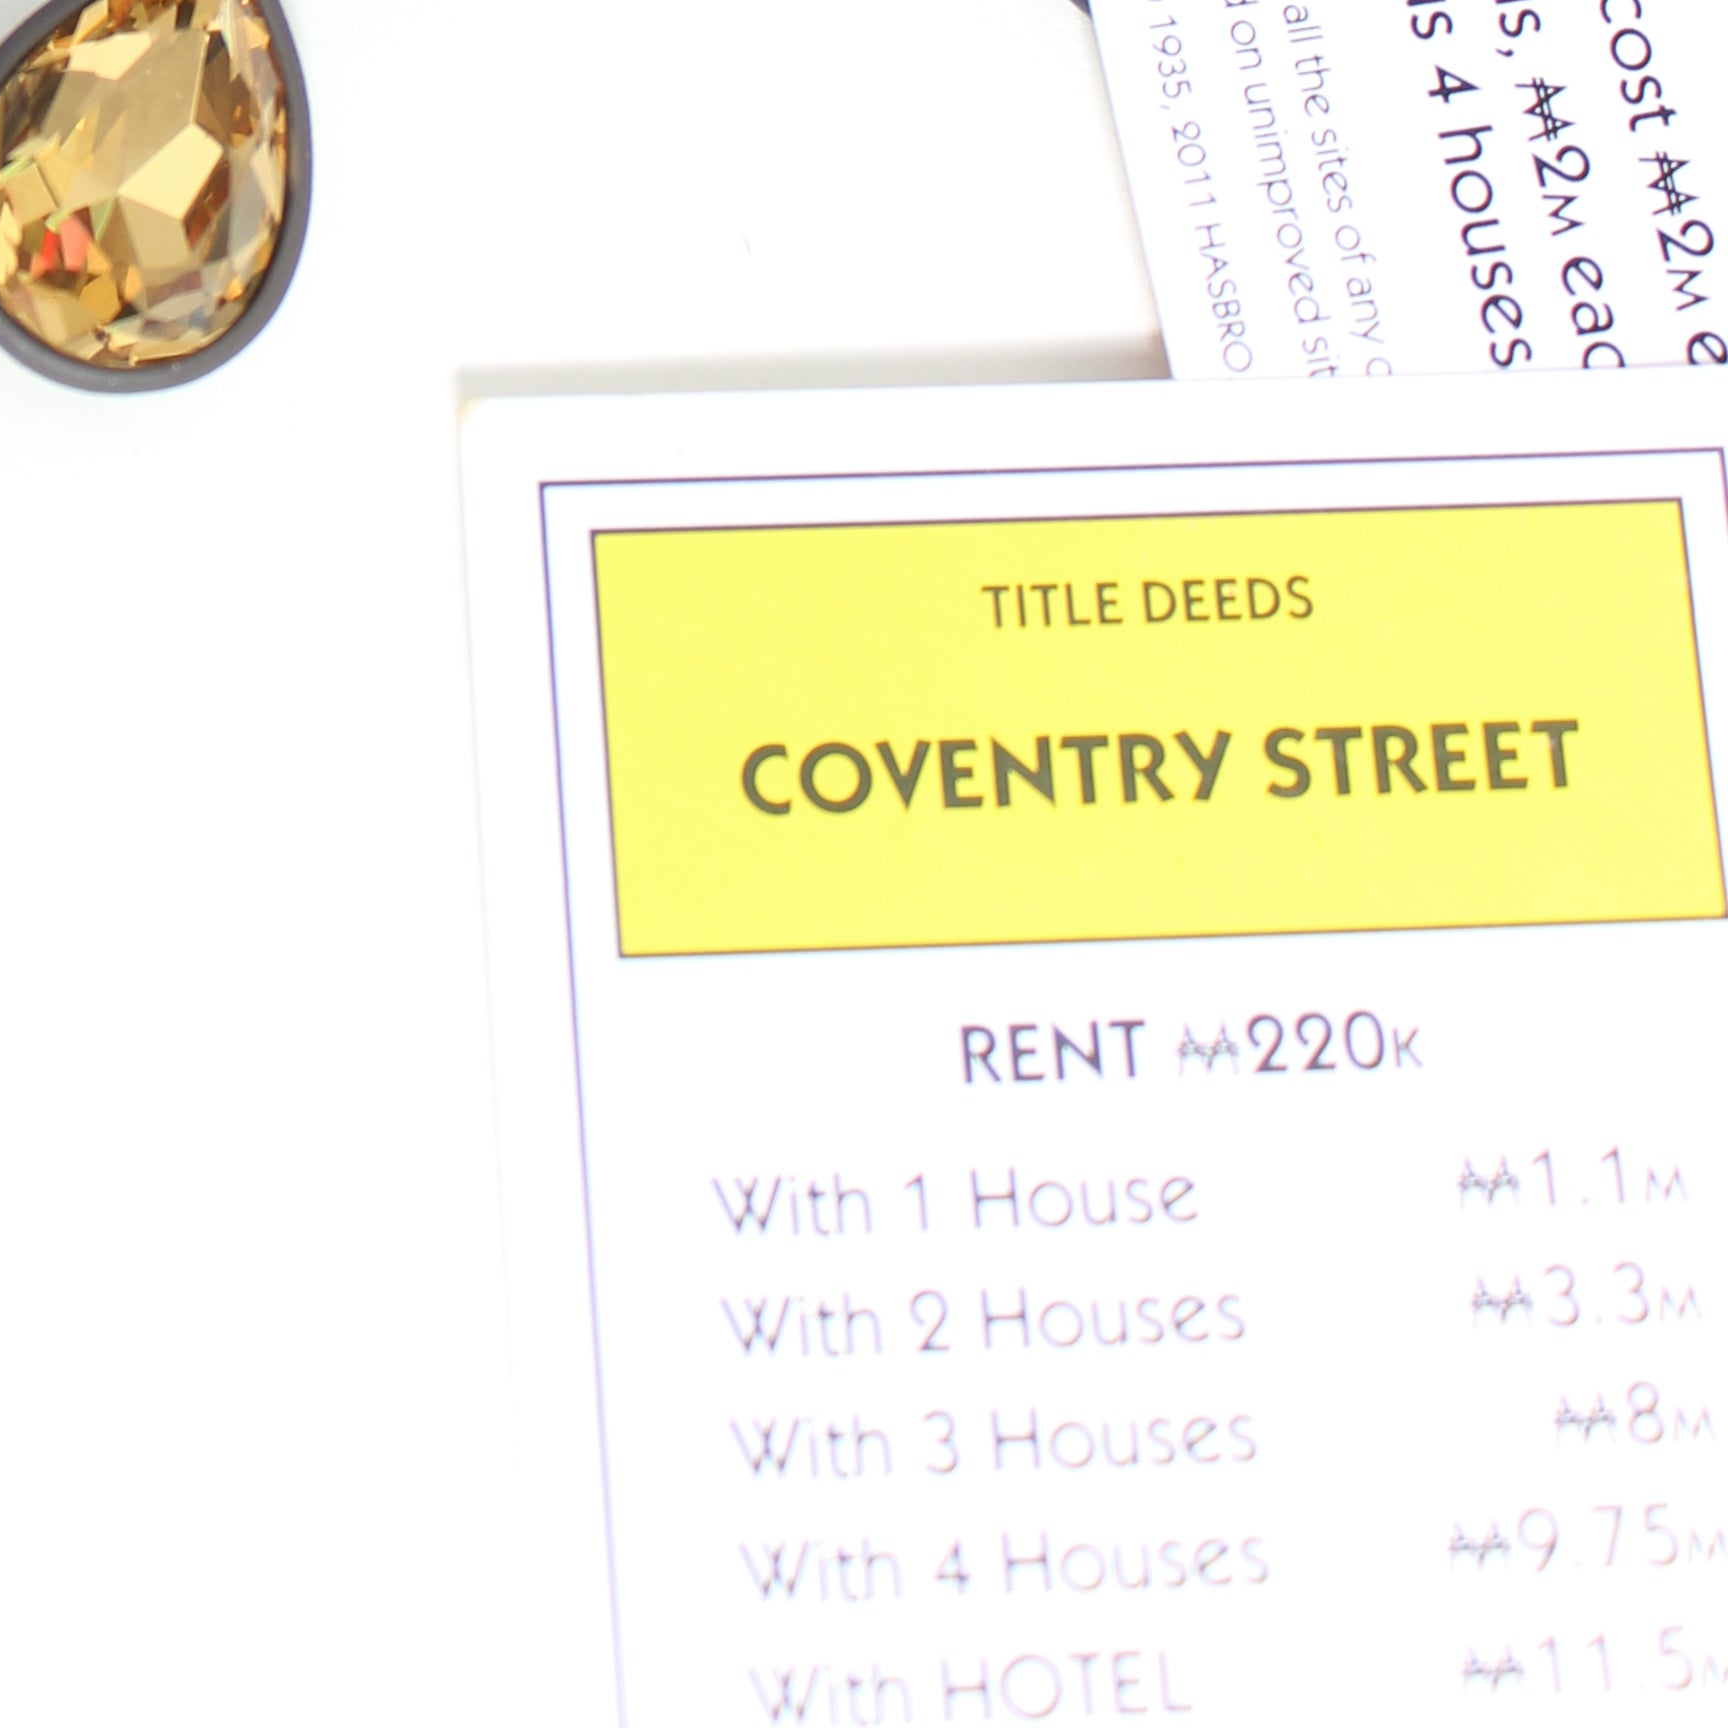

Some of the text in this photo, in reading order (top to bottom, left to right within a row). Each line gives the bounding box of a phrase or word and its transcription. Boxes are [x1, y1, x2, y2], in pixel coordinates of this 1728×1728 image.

[1230, 20, 1263, 71] on
[1283, 4, 1323, 44] all
[1149, 14, 1193, 111] 1935,
[1295, 55, 1331, 117] the
[1428, 65, 1481, 104] 4
[1170, 120, 1217, 208] 2011
[1311, 128, 1353, 213] sites
[1243, 82, 1332, 324] unimproved
[1335, 224, 1377, 263] of
[1438, 124, 1533, 369] houses
[1194, 223, 1254, 373] HASBRO
[1346, 277, 1385, 344] any
[982, 575, 1316, 630] TITLE DEEDS
[739, 718, 1582, 817] COVENTRY STREET
[961, 1019, 1147, 1086] RENT
[711, 1173, 872, 1237] With
[904, 1173, 929, 1232] 1
[971, 1165, 1198, 1231] House
[720, 1291, 883, 1358] With
[909, 1288, 952, 1353] 2
[981, 1285, 1246, 1350] Houses
[729, 1413, 893, 1480] With
[923, 1409, 960, 1476] 3
[990, 1406, 1257, 1472] Houses
[738, 1537, 903, 1603] With
[934, 1538, 972, 1596] 4
[1000, 1530, 1270, 1595] Houses
[747, 1661, 913, 1727] With
[939, 1649, 1194, 1724] HOTEL
